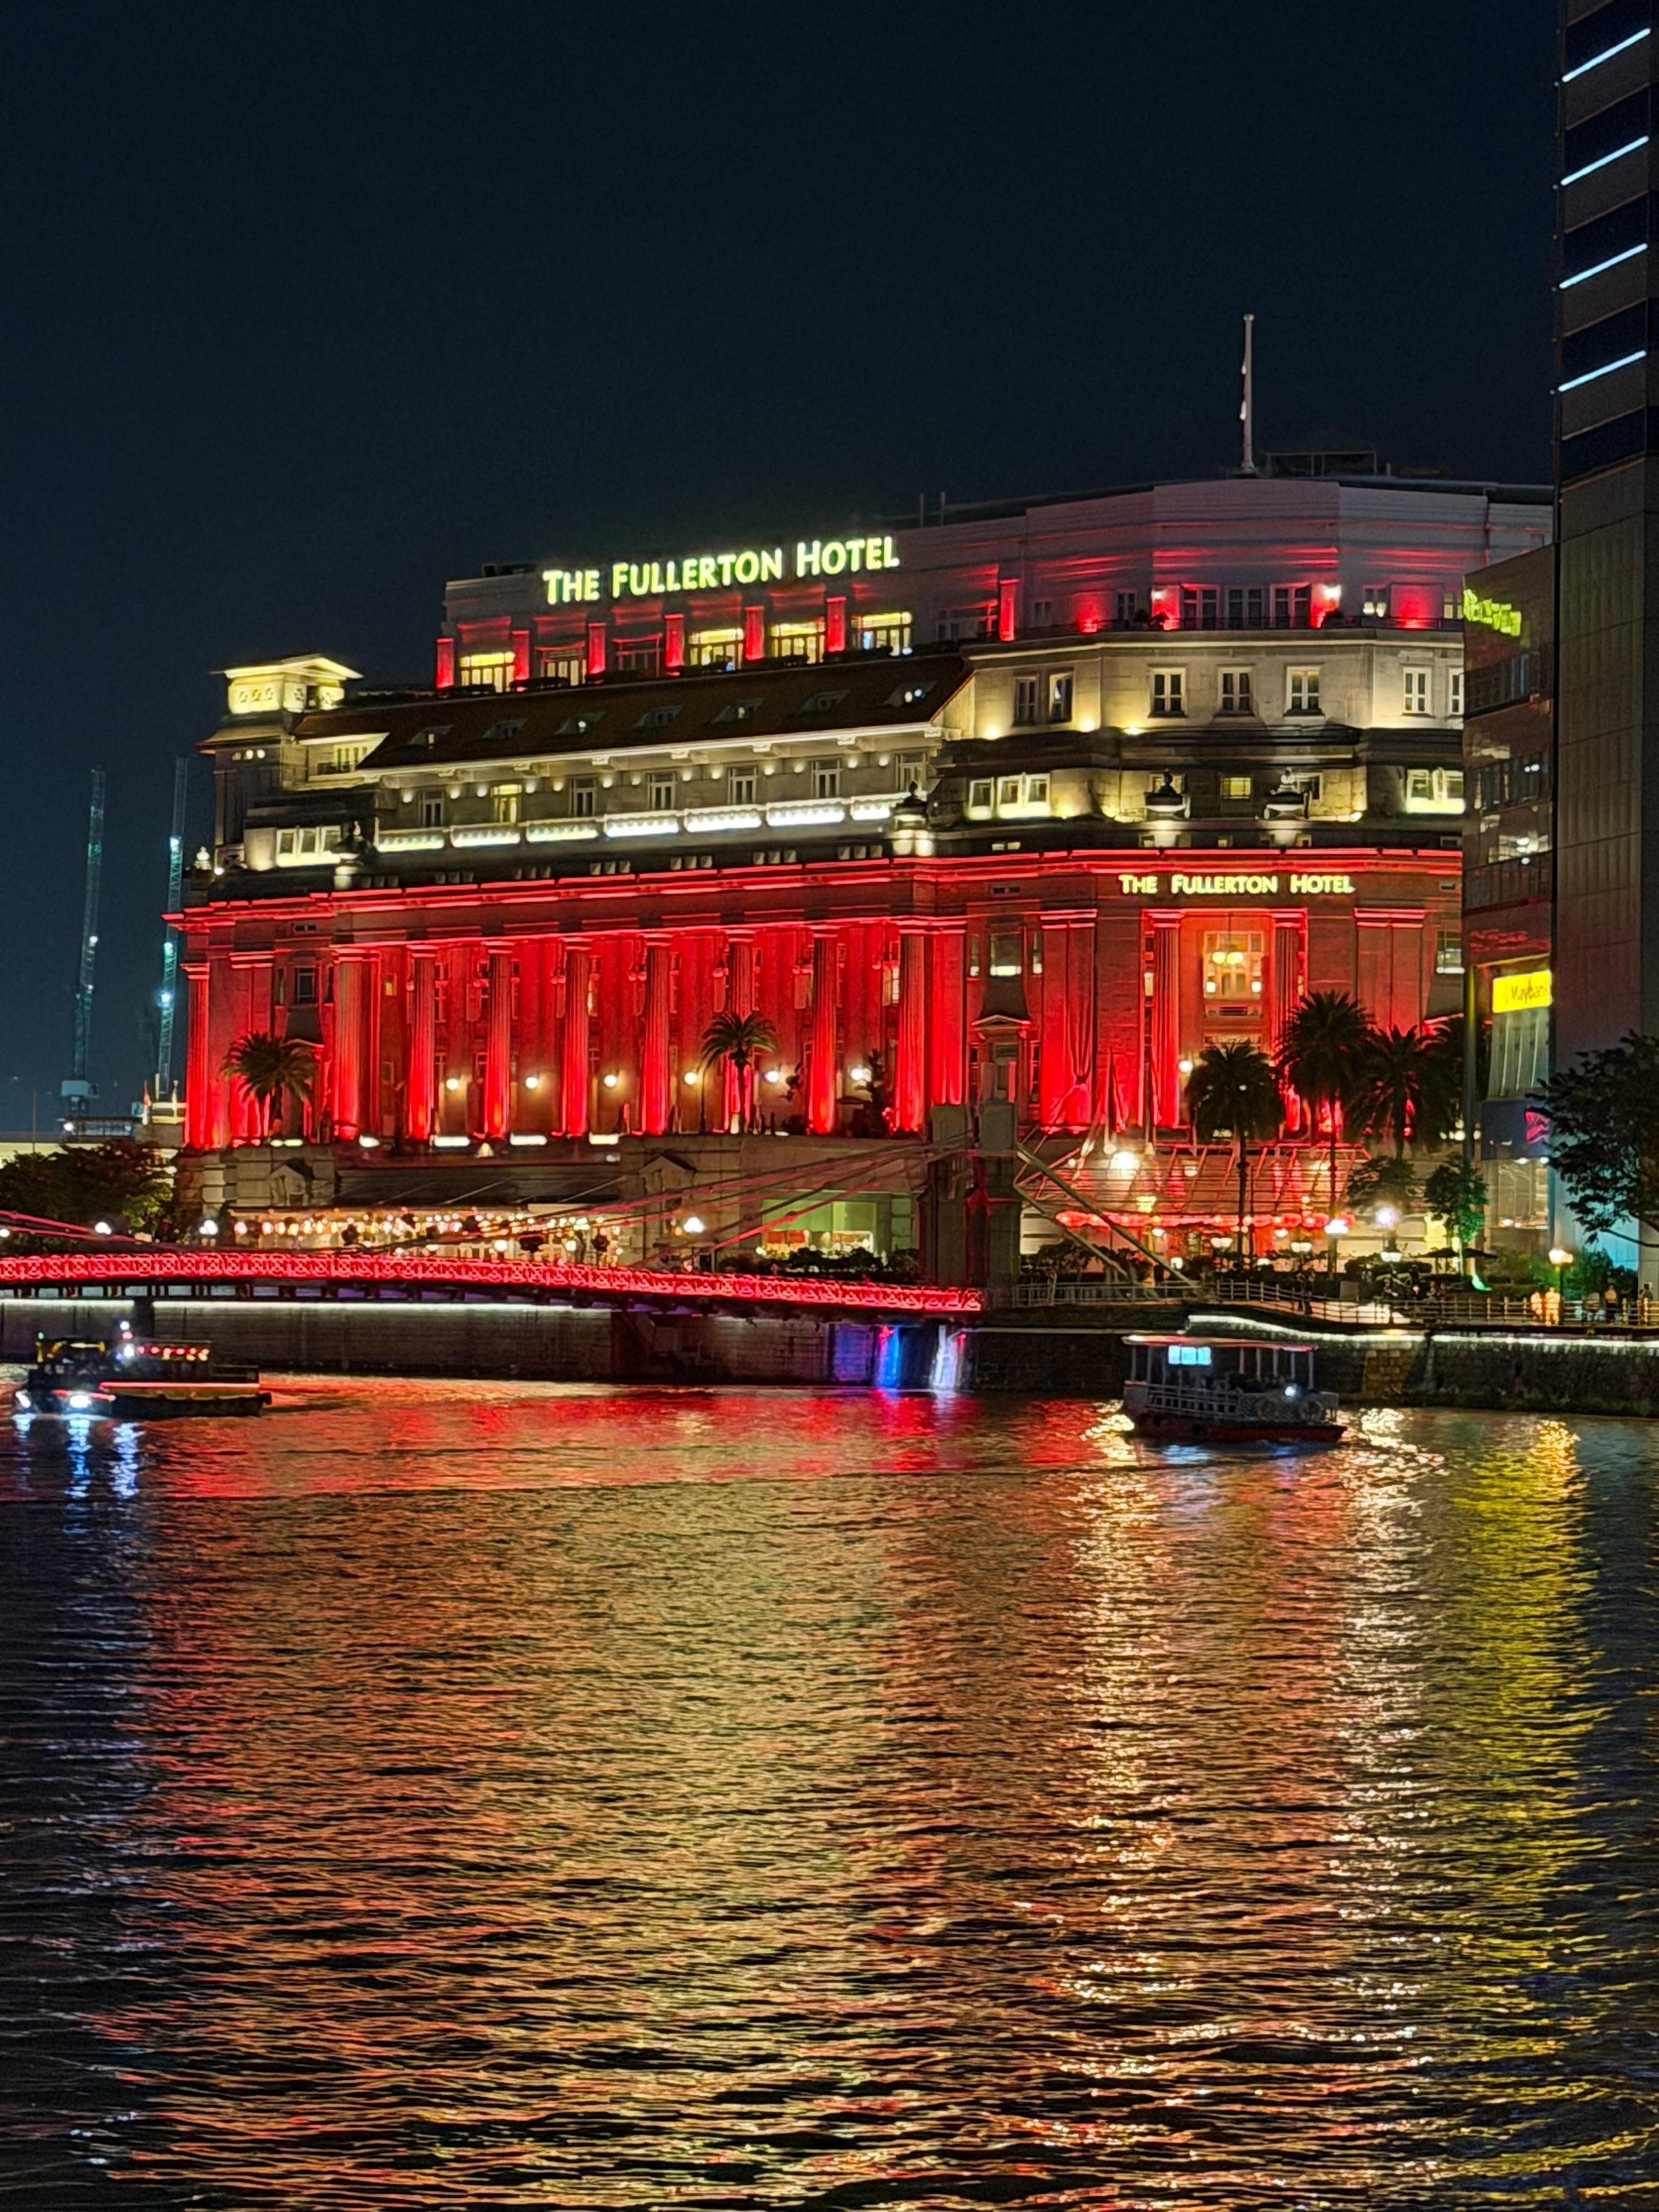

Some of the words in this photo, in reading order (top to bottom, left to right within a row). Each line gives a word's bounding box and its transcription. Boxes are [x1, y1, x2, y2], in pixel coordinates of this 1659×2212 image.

[543, 569, 600, 605] THE
[612, 548, 782, 598] FULLERTON
[797, 536, 900, 577] HOTEL
[1118, 874, 1158, 894] THE
[1171, 874, 1278, 894] FULLERTON
[1290, 874, 1356, 894] HOTEL
